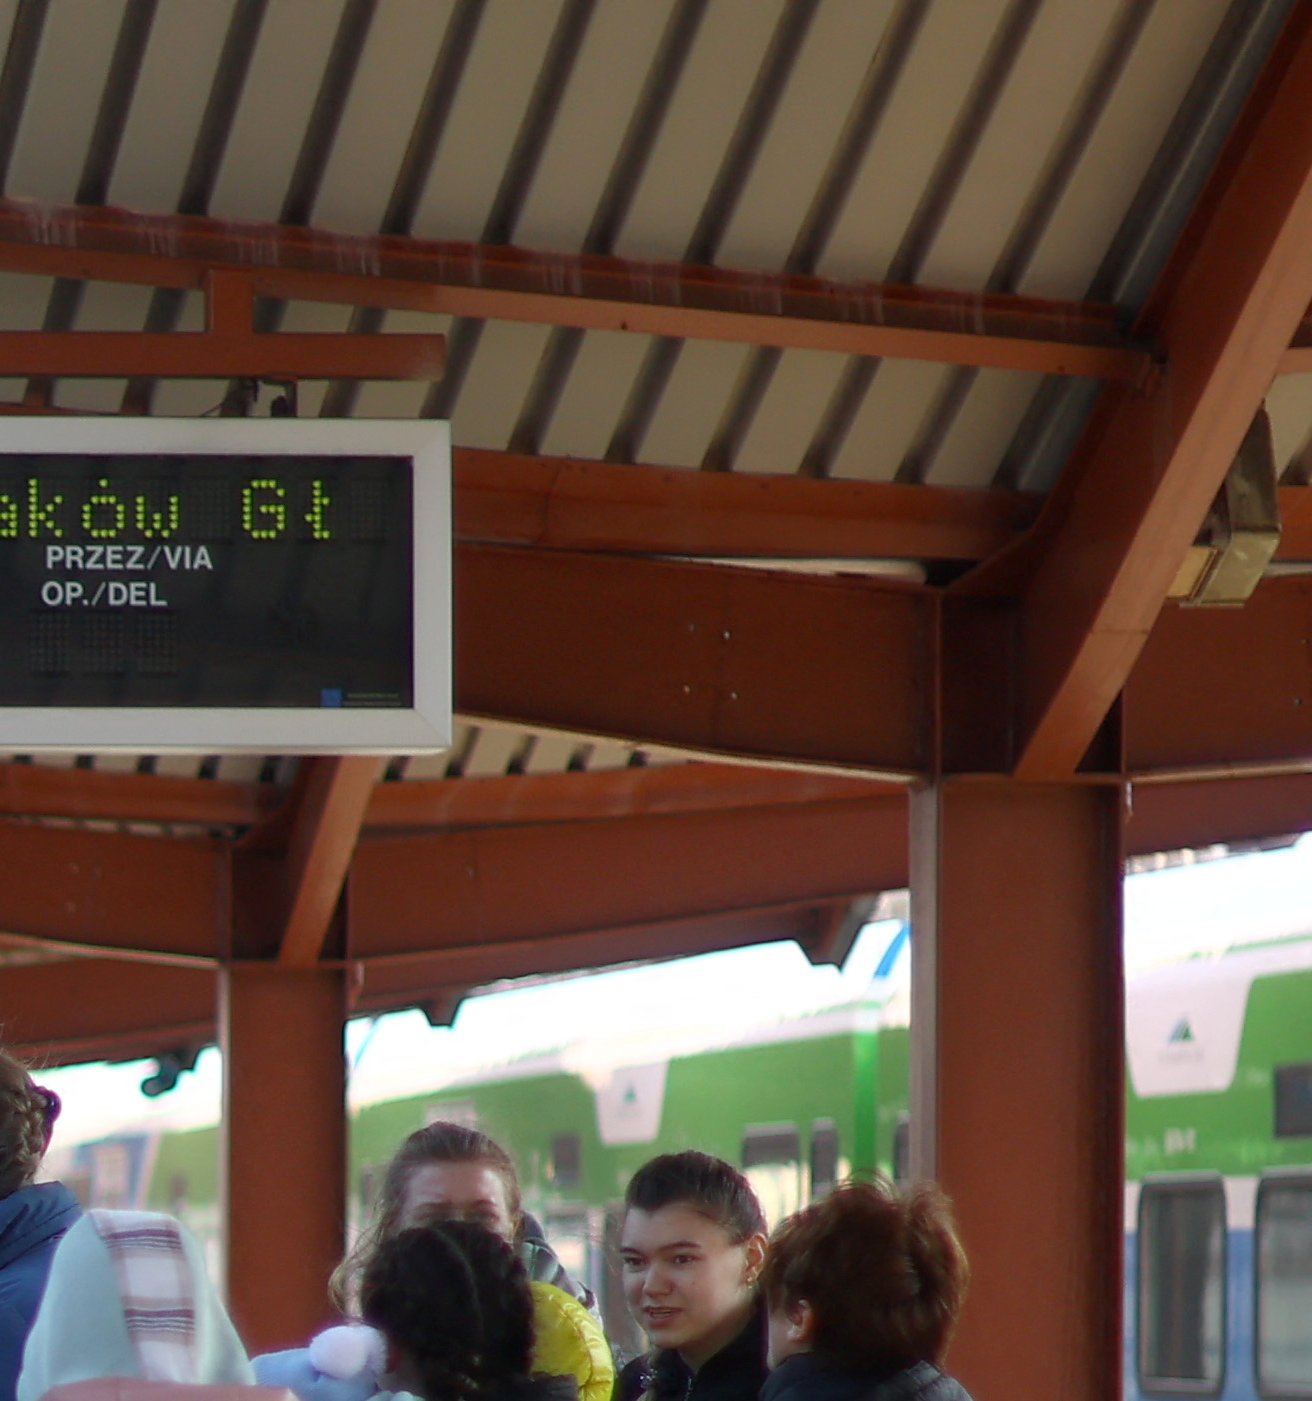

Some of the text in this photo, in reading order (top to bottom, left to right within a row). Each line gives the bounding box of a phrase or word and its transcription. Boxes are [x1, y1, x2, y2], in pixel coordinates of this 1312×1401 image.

[243, 480, 329, 538] Gł
[47, 546, 212, 569] PRZEZ/VIA
[42, 581, 166, 605] OP./DEL
